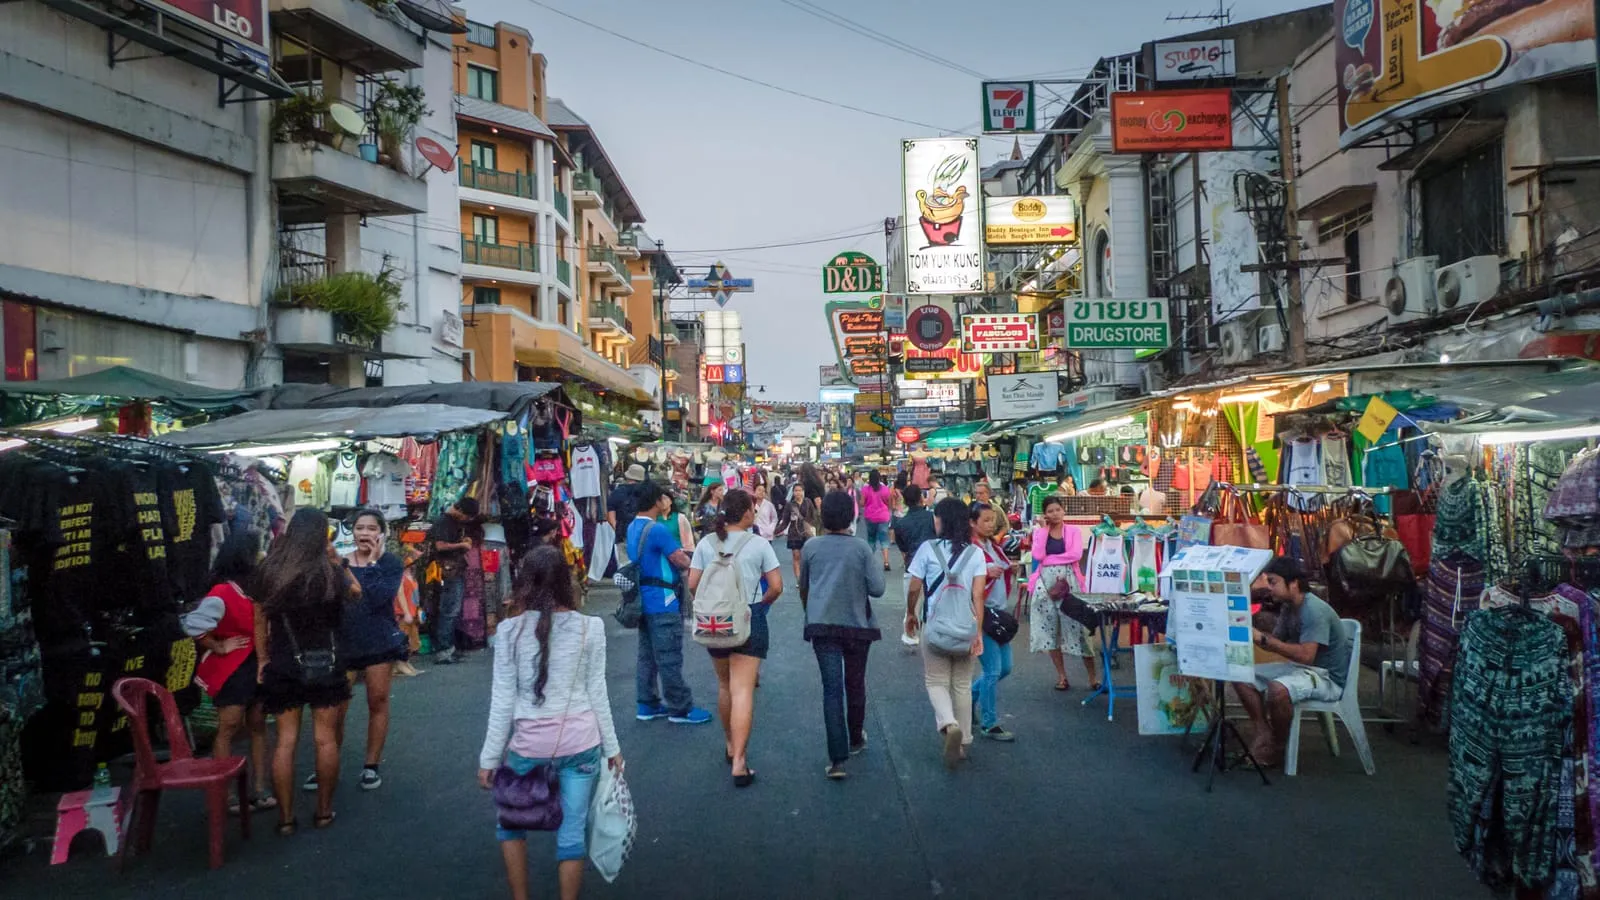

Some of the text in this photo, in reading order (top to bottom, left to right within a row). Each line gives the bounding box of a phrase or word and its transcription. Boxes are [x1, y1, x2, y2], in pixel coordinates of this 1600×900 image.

[214, 3, 252, 38] LEO
[993, 89, 1024, 128] 7
[1120, 112, 1227, 128] money exchange
[1018, 203, 1042, 213] Buddy
[910, 253, 979, 268] TOM YUM KUNG
[827, 267, 872, 291] D&D
[1073, 301, 1162, 320] ขายยา
[1073, 327, 1162, 342] DRUGSTORE
[85, 672, 102, 687] no
[80, 711, 95, 726] no
